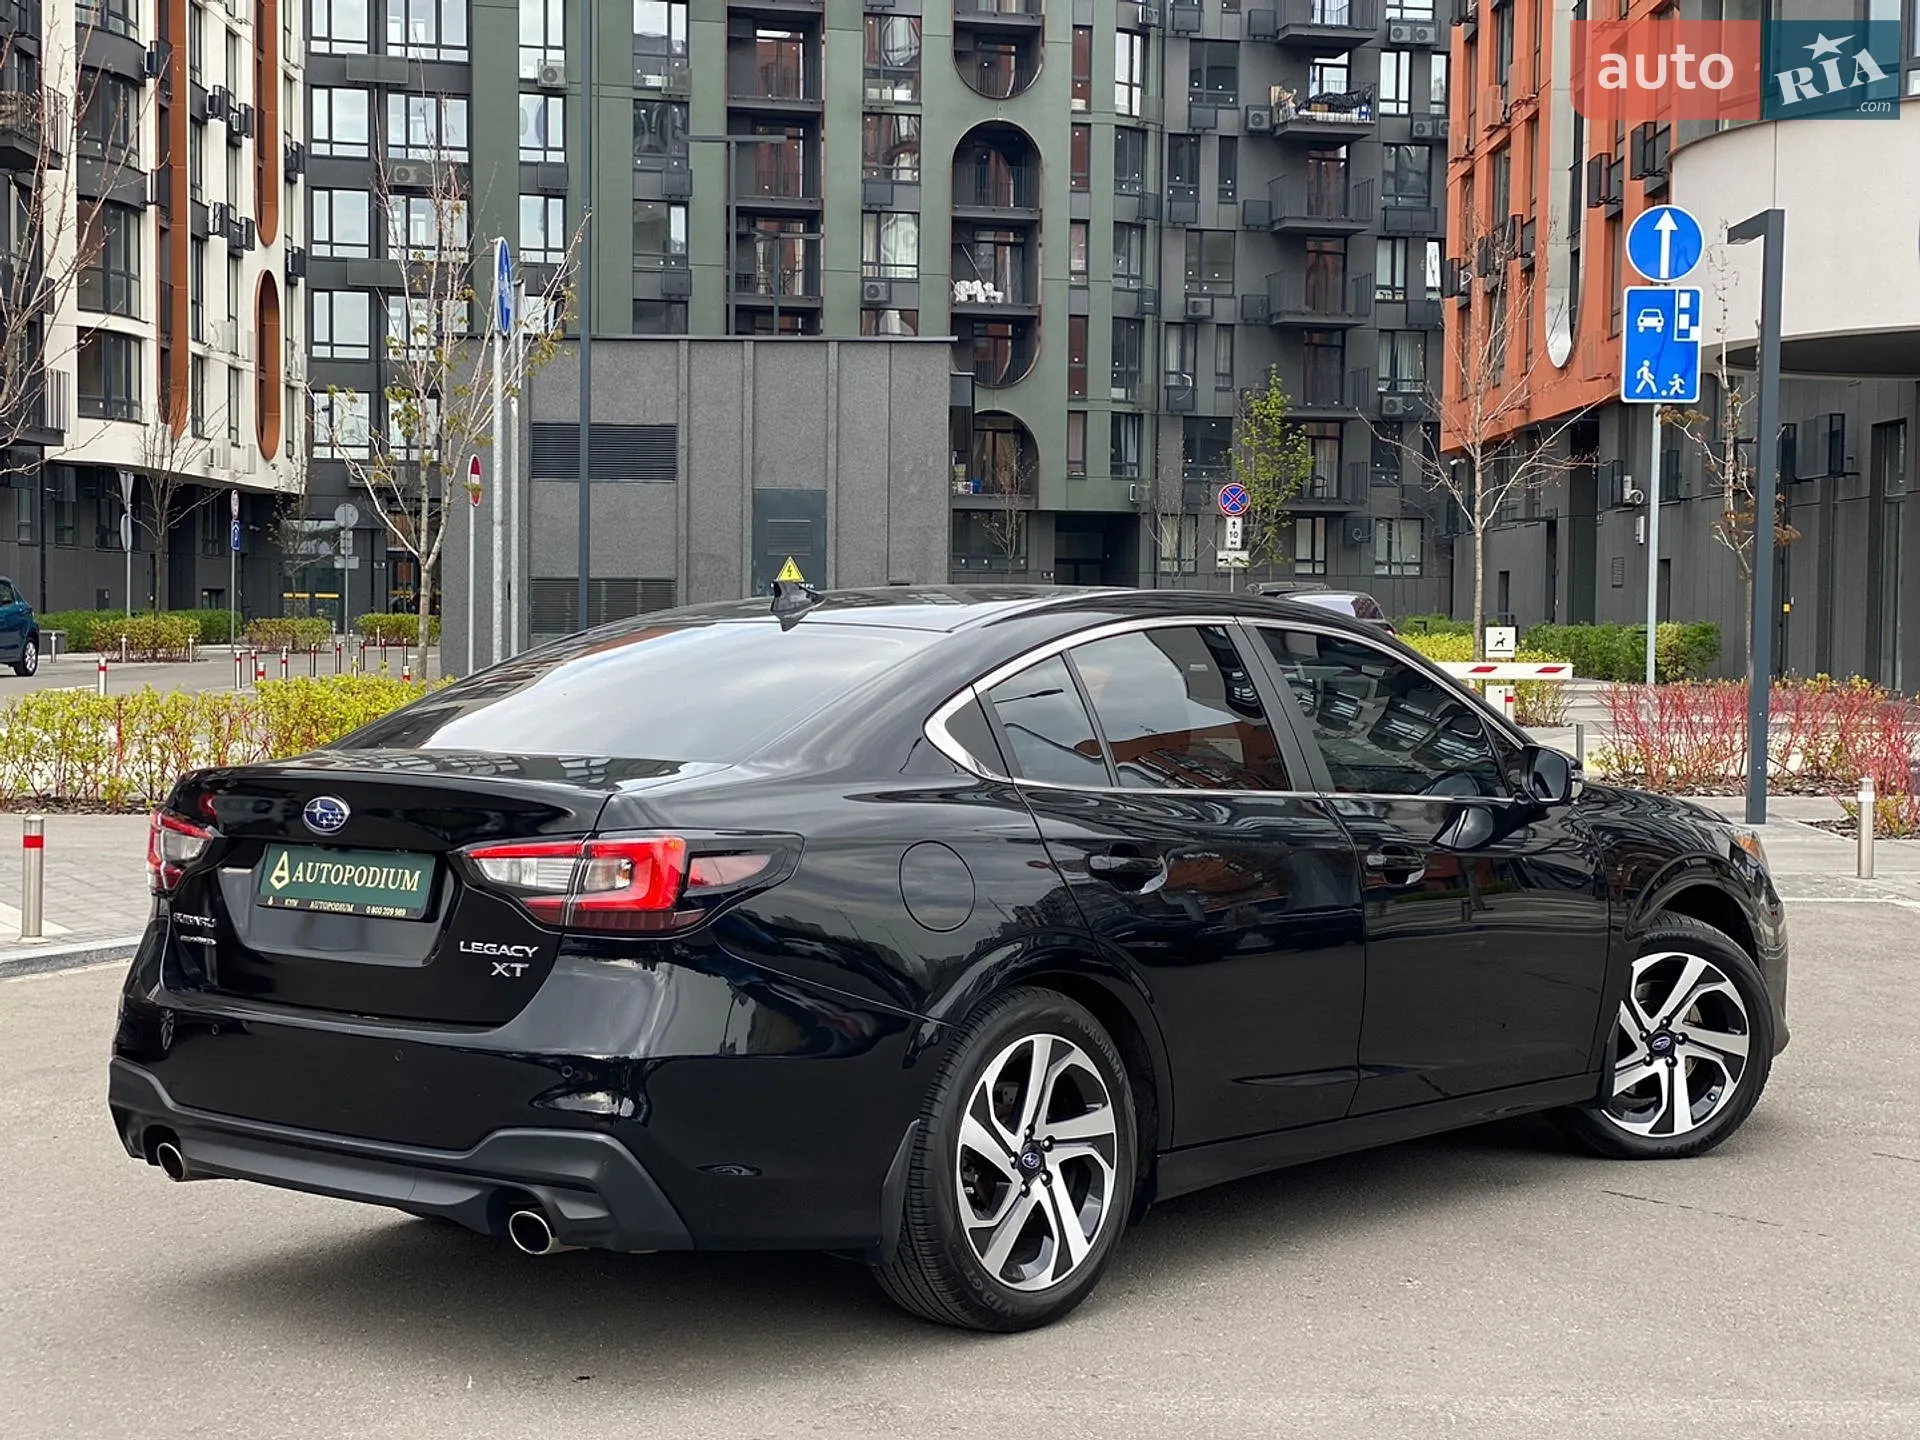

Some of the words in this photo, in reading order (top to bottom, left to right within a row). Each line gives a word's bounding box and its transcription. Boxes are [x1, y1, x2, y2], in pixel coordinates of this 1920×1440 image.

[292, 861, 422, 891] AUTOPODIUM
[459, 940, 539, 958] LEGACY
[490, 961, 530, 977] XT
